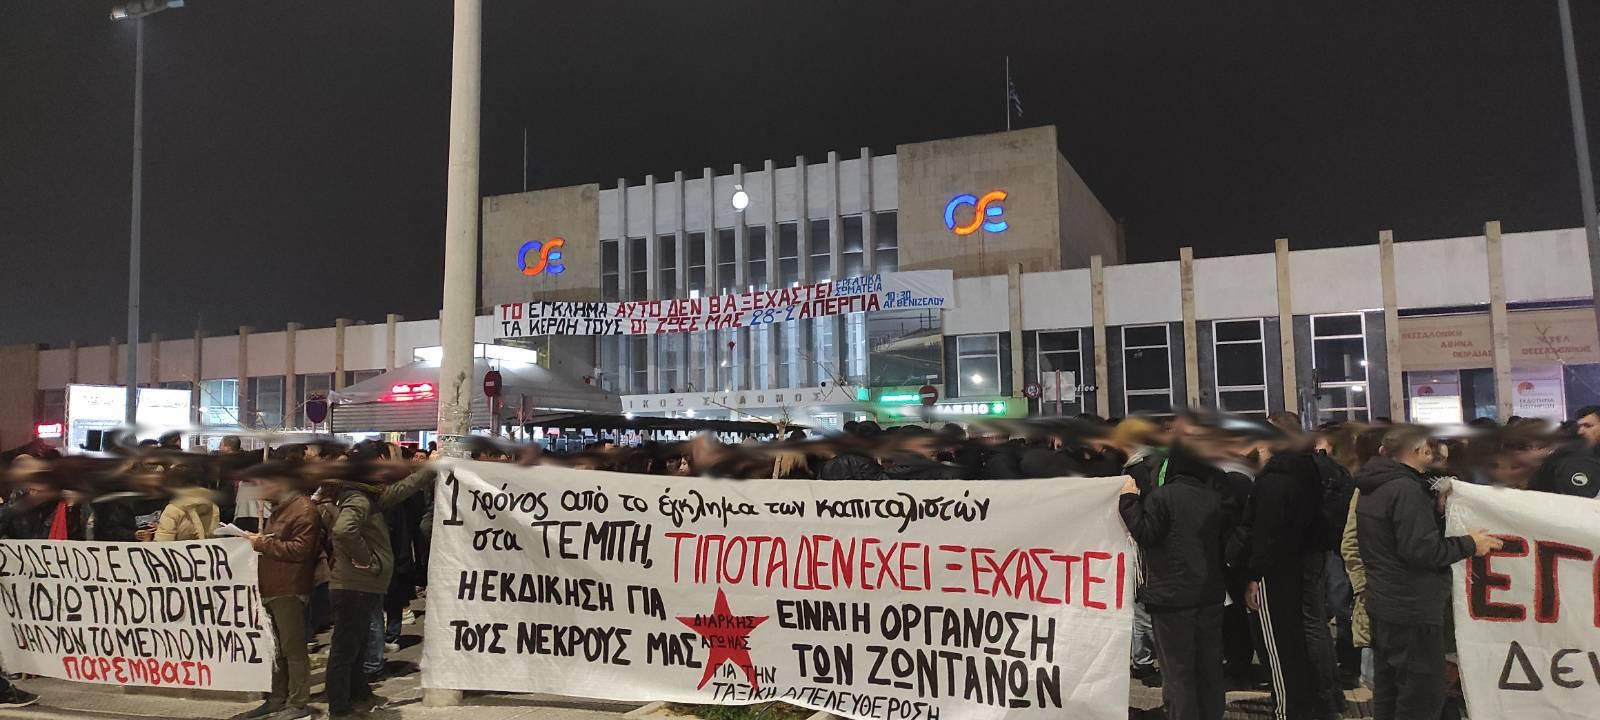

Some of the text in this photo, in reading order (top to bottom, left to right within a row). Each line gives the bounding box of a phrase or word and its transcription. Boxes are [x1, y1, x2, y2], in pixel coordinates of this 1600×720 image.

[501, 302, 522, 320] ΤΟ
[528, 301, 608, 318] ΕΓΚΛΗΜΑ
[614, 301, 661, 319] ΑΥΤΟ
[667, 298, 702, 318] ΔΕΝ
[741, 283, 833, 311] ΞΕΧΑΣΤΕΙ
[502, 321, 522, 337] ΤΑ
[529, 319, 578, 336] ΚΕΡΔΗ
[584, 318, 624, 335] ΤΟΥΣ
[631, 318, 647, 334] ΟΙ
[705, 311, 744, 330] ΜΑΣ
[798, 293, 881, 320] ΑΠΕΡΓΙΑ
[443, 471, 990, 534] 1 χρόνος από το έγκλημα των καπιταλιστών
[472, 528, 524, 552] στα
[664, 532, 788, 588] ΤΙΠΟΤΑ
[793, 534, 856, 591] ΔΕΝ
[860, 537, 930, 592] ΕΧΕΙ
[938, 544, 1125, 610] ΞΕΧΑΣΤΕΙ
[1465, 534, 1600, 629] ΕΓ
[480, 569, 616, 612] ΕΚΔΙΚΗΣΗ
[626, 584, 667, 621] ΓΙΑ
[776, 598, 847, 632] ΕΙΝΑΙ
[693, 613, 757, 629] ΔΙΑΡΚΗΣ
[217, 629, 263, 664] ΜΑΣ
[449, 620, 509, 654] ΤΟΥΣ
[516, 622, 632, 666] ΝΕΚΡΟΥΣ
[646, 632, 702, 669] ΜΑΣ
[713, 682, 778, 701] ΤΑΞΙΚΗ
[714, 663, 777, 684] ΓΙΑ ΤΗΝ
